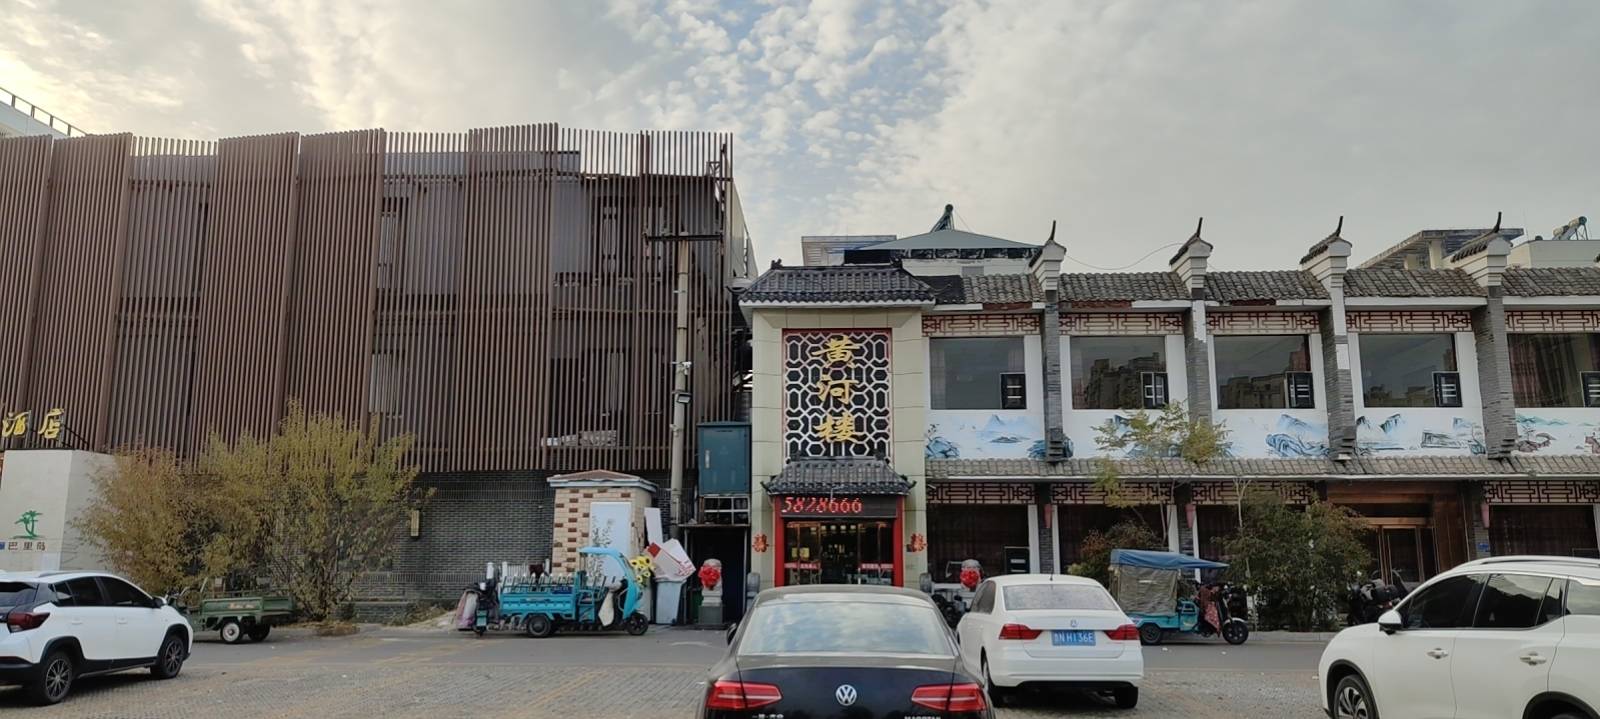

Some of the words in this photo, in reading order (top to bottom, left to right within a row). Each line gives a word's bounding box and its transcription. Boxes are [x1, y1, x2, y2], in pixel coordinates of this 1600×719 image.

[812, 334, 861, 443] 黄河楼
[2, 408, 64, 439] 酒店
[781, 497, 862, 513] 5828666
